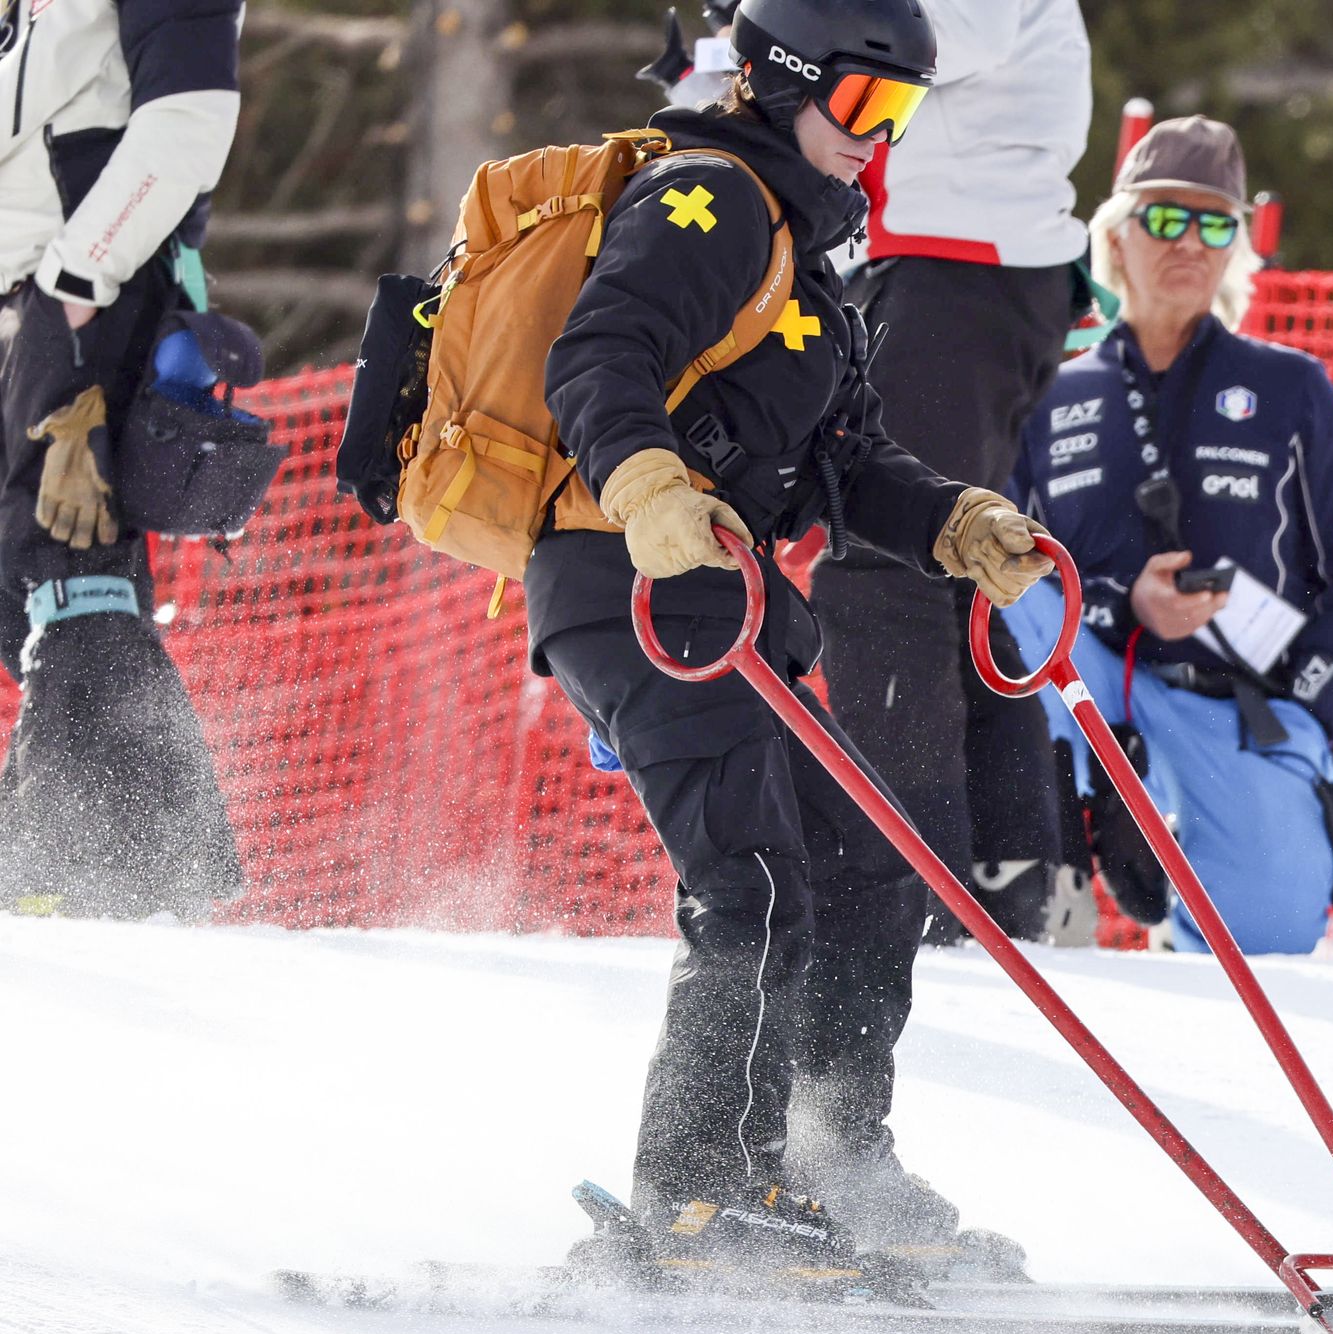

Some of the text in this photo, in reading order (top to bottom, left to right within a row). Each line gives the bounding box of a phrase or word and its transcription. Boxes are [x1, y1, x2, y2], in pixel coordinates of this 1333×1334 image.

[755, 246, 788, 314] ORTOVOX
[1050, 398, 1104, 428] EA7
[1202, 474, 1259, 500] enel
[720, 1207, 828, 1241] FISCHER
